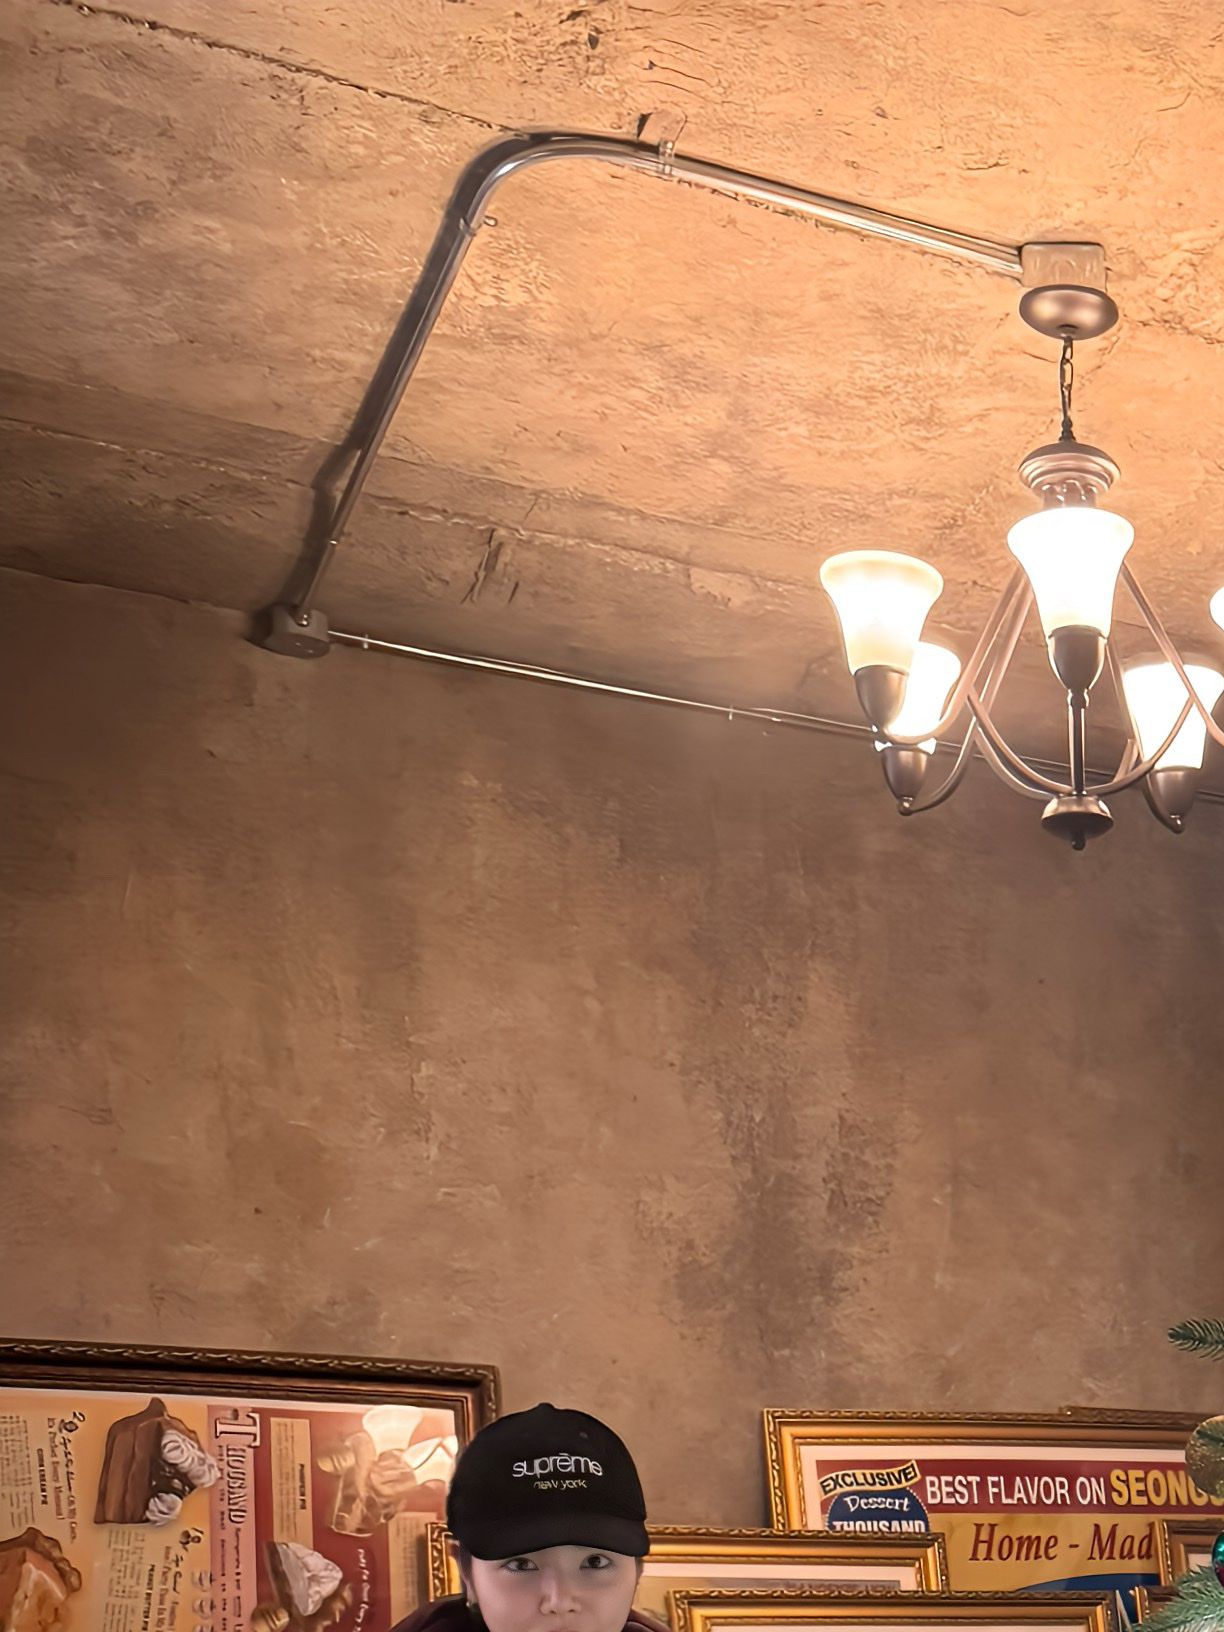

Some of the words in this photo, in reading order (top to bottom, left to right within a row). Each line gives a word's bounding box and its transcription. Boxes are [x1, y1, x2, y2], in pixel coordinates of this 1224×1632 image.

[215, 1412, 261, 1525] THOUSAND
[560, 1479, 587, 1490] york
[925, 1475, 980, 1505] BEST
[987, 1476, 1070, 1505] FLAVOR
[1075, 1477, 1106, 1505] ON
[843, 1495, 911, 1512] Dessert
[968, 1522, 1059, 1561] Home
